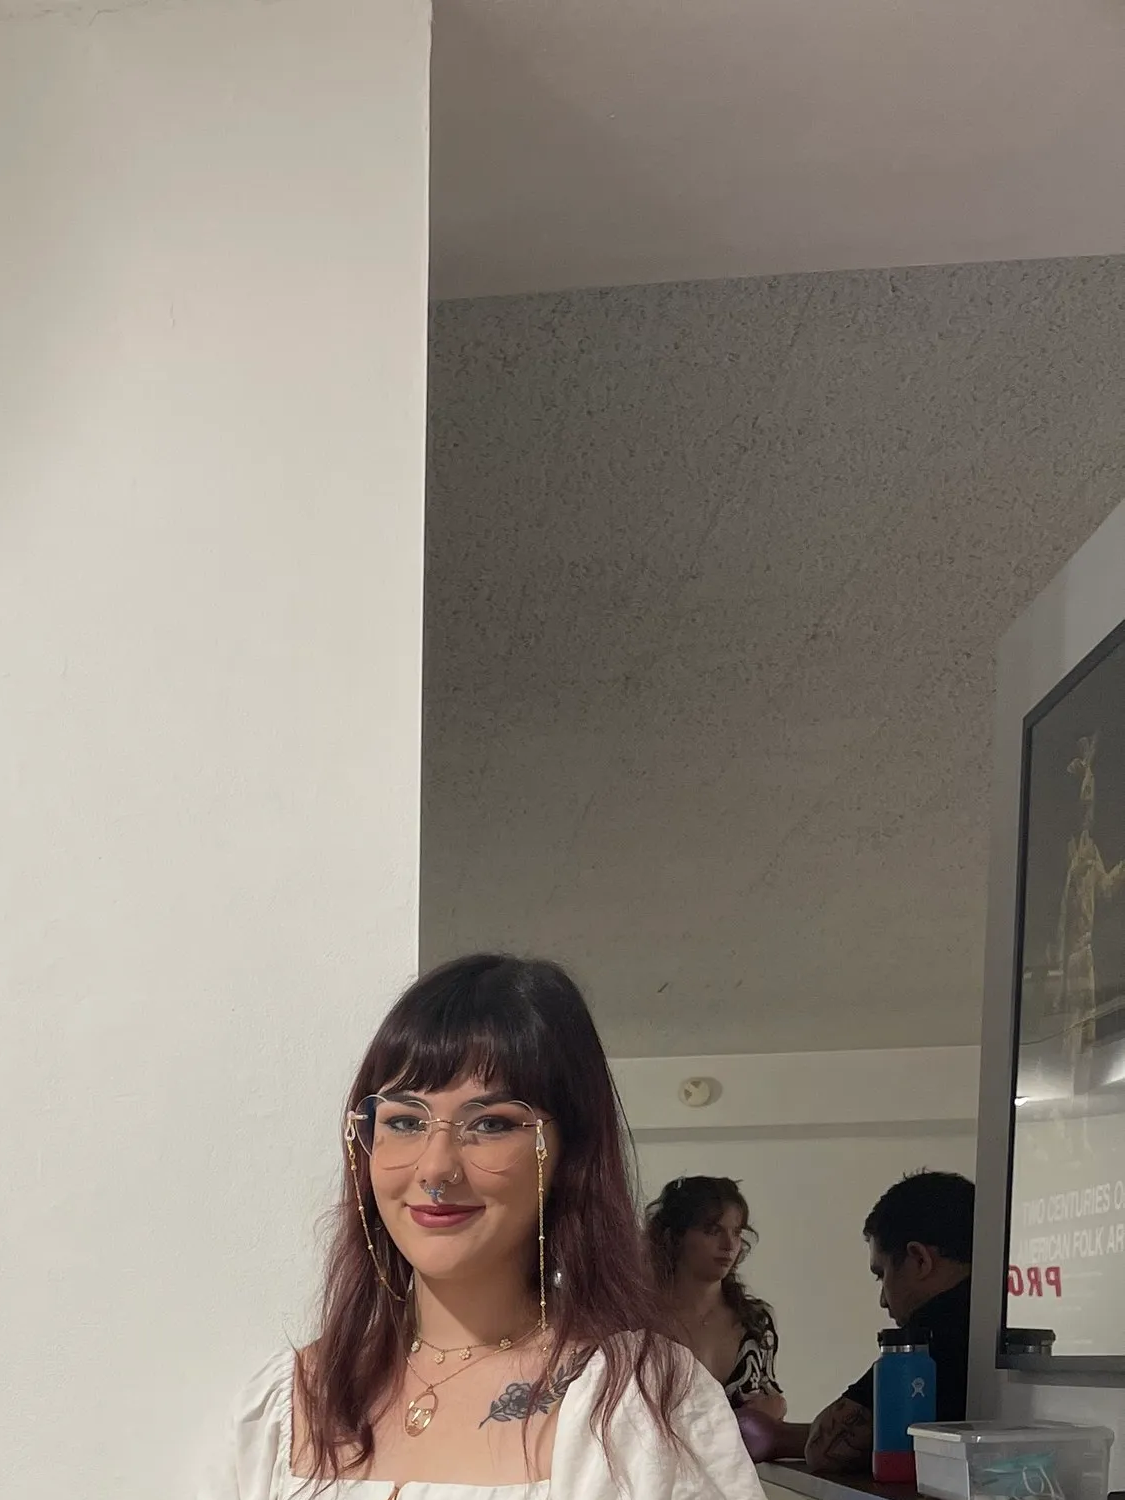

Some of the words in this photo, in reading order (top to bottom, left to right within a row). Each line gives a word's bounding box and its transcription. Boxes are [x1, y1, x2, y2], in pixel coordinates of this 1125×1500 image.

[1023, 1198, 1045, 1227] TWO
[1047, 1182, 1110, 1221] CENTURIES
[1114, 1180, 1125, 1210] O
[1017, 1230, 1071, 1266] AMERICAN
[1073, 1226, 1104, 1258] FOLK
